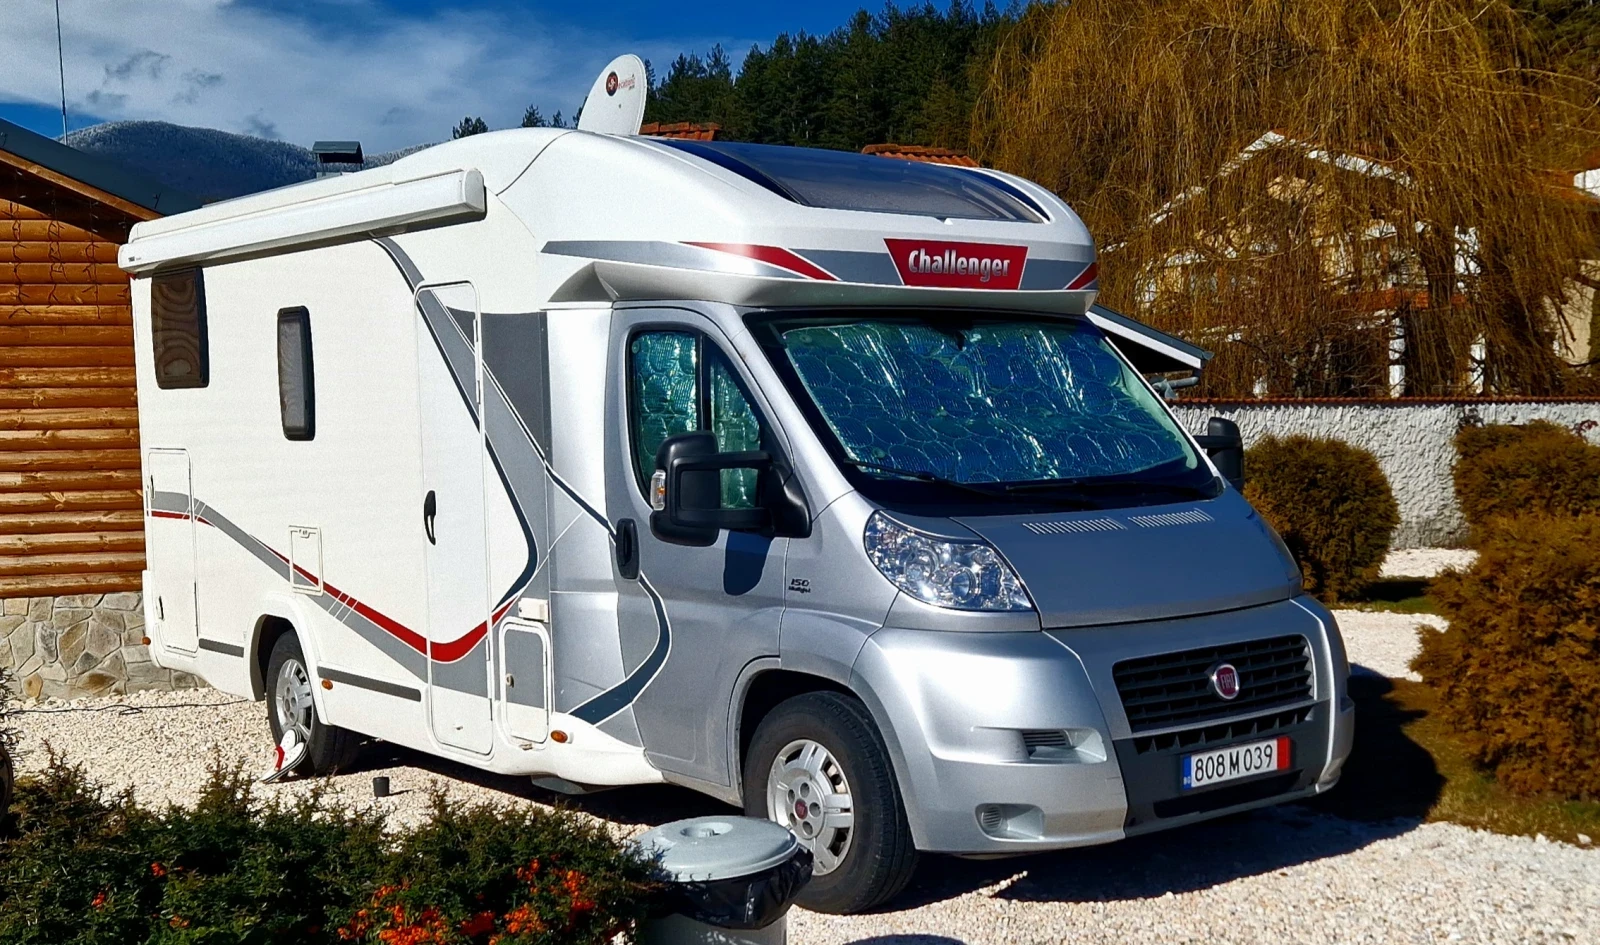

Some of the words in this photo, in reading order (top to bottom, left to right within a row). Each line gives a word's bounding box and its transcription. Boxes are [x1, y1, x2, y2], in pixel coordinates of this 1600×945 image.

[908, 248, 1011, 282] Challenger
[791, 578, 810, 587] 150
[1220, 673, 1235, 689] FIAT
[1194, 754, 1226, 782] 808
[1229, 750, 1240, 776] M
[1243, 744, 1273, 772] 039
